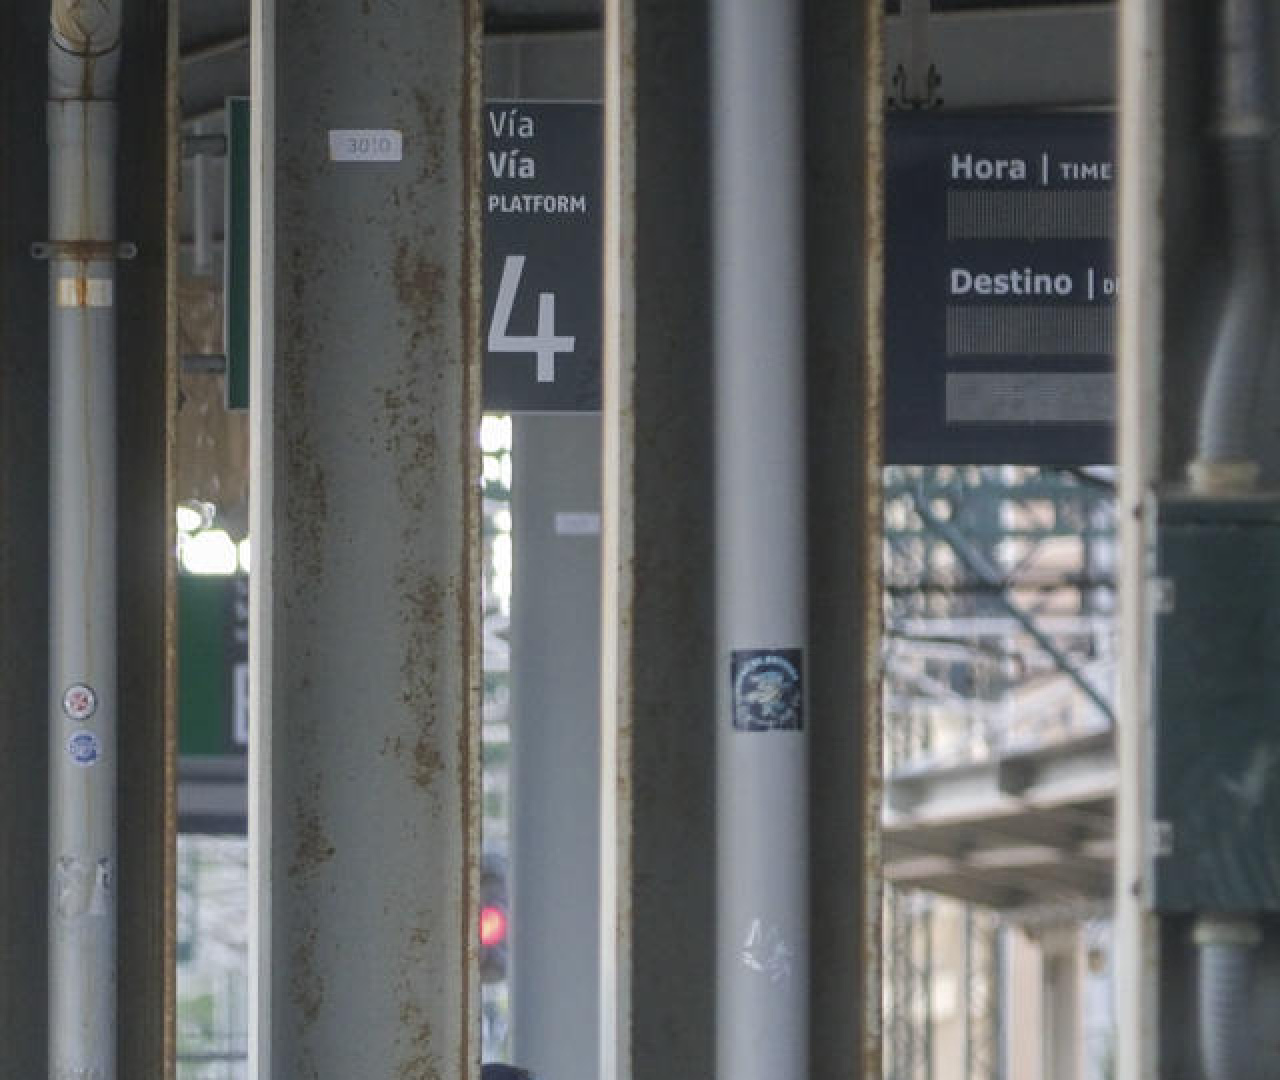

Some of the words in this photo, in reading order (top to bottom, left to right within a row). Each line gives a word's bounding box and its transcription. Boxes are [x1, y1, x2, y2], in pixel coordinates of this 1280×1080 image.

[490, 109, 535, 138] Vía
[489, 150, 535, 179] Vía
[951, 153, 1027, 181] Hora
[1060, 162, 1114, 181] TIME
[489, 195, 587, 213] PLATFORM
[950, 266, 1073, 295] Destino
[488, 255, 575, 383] 4
